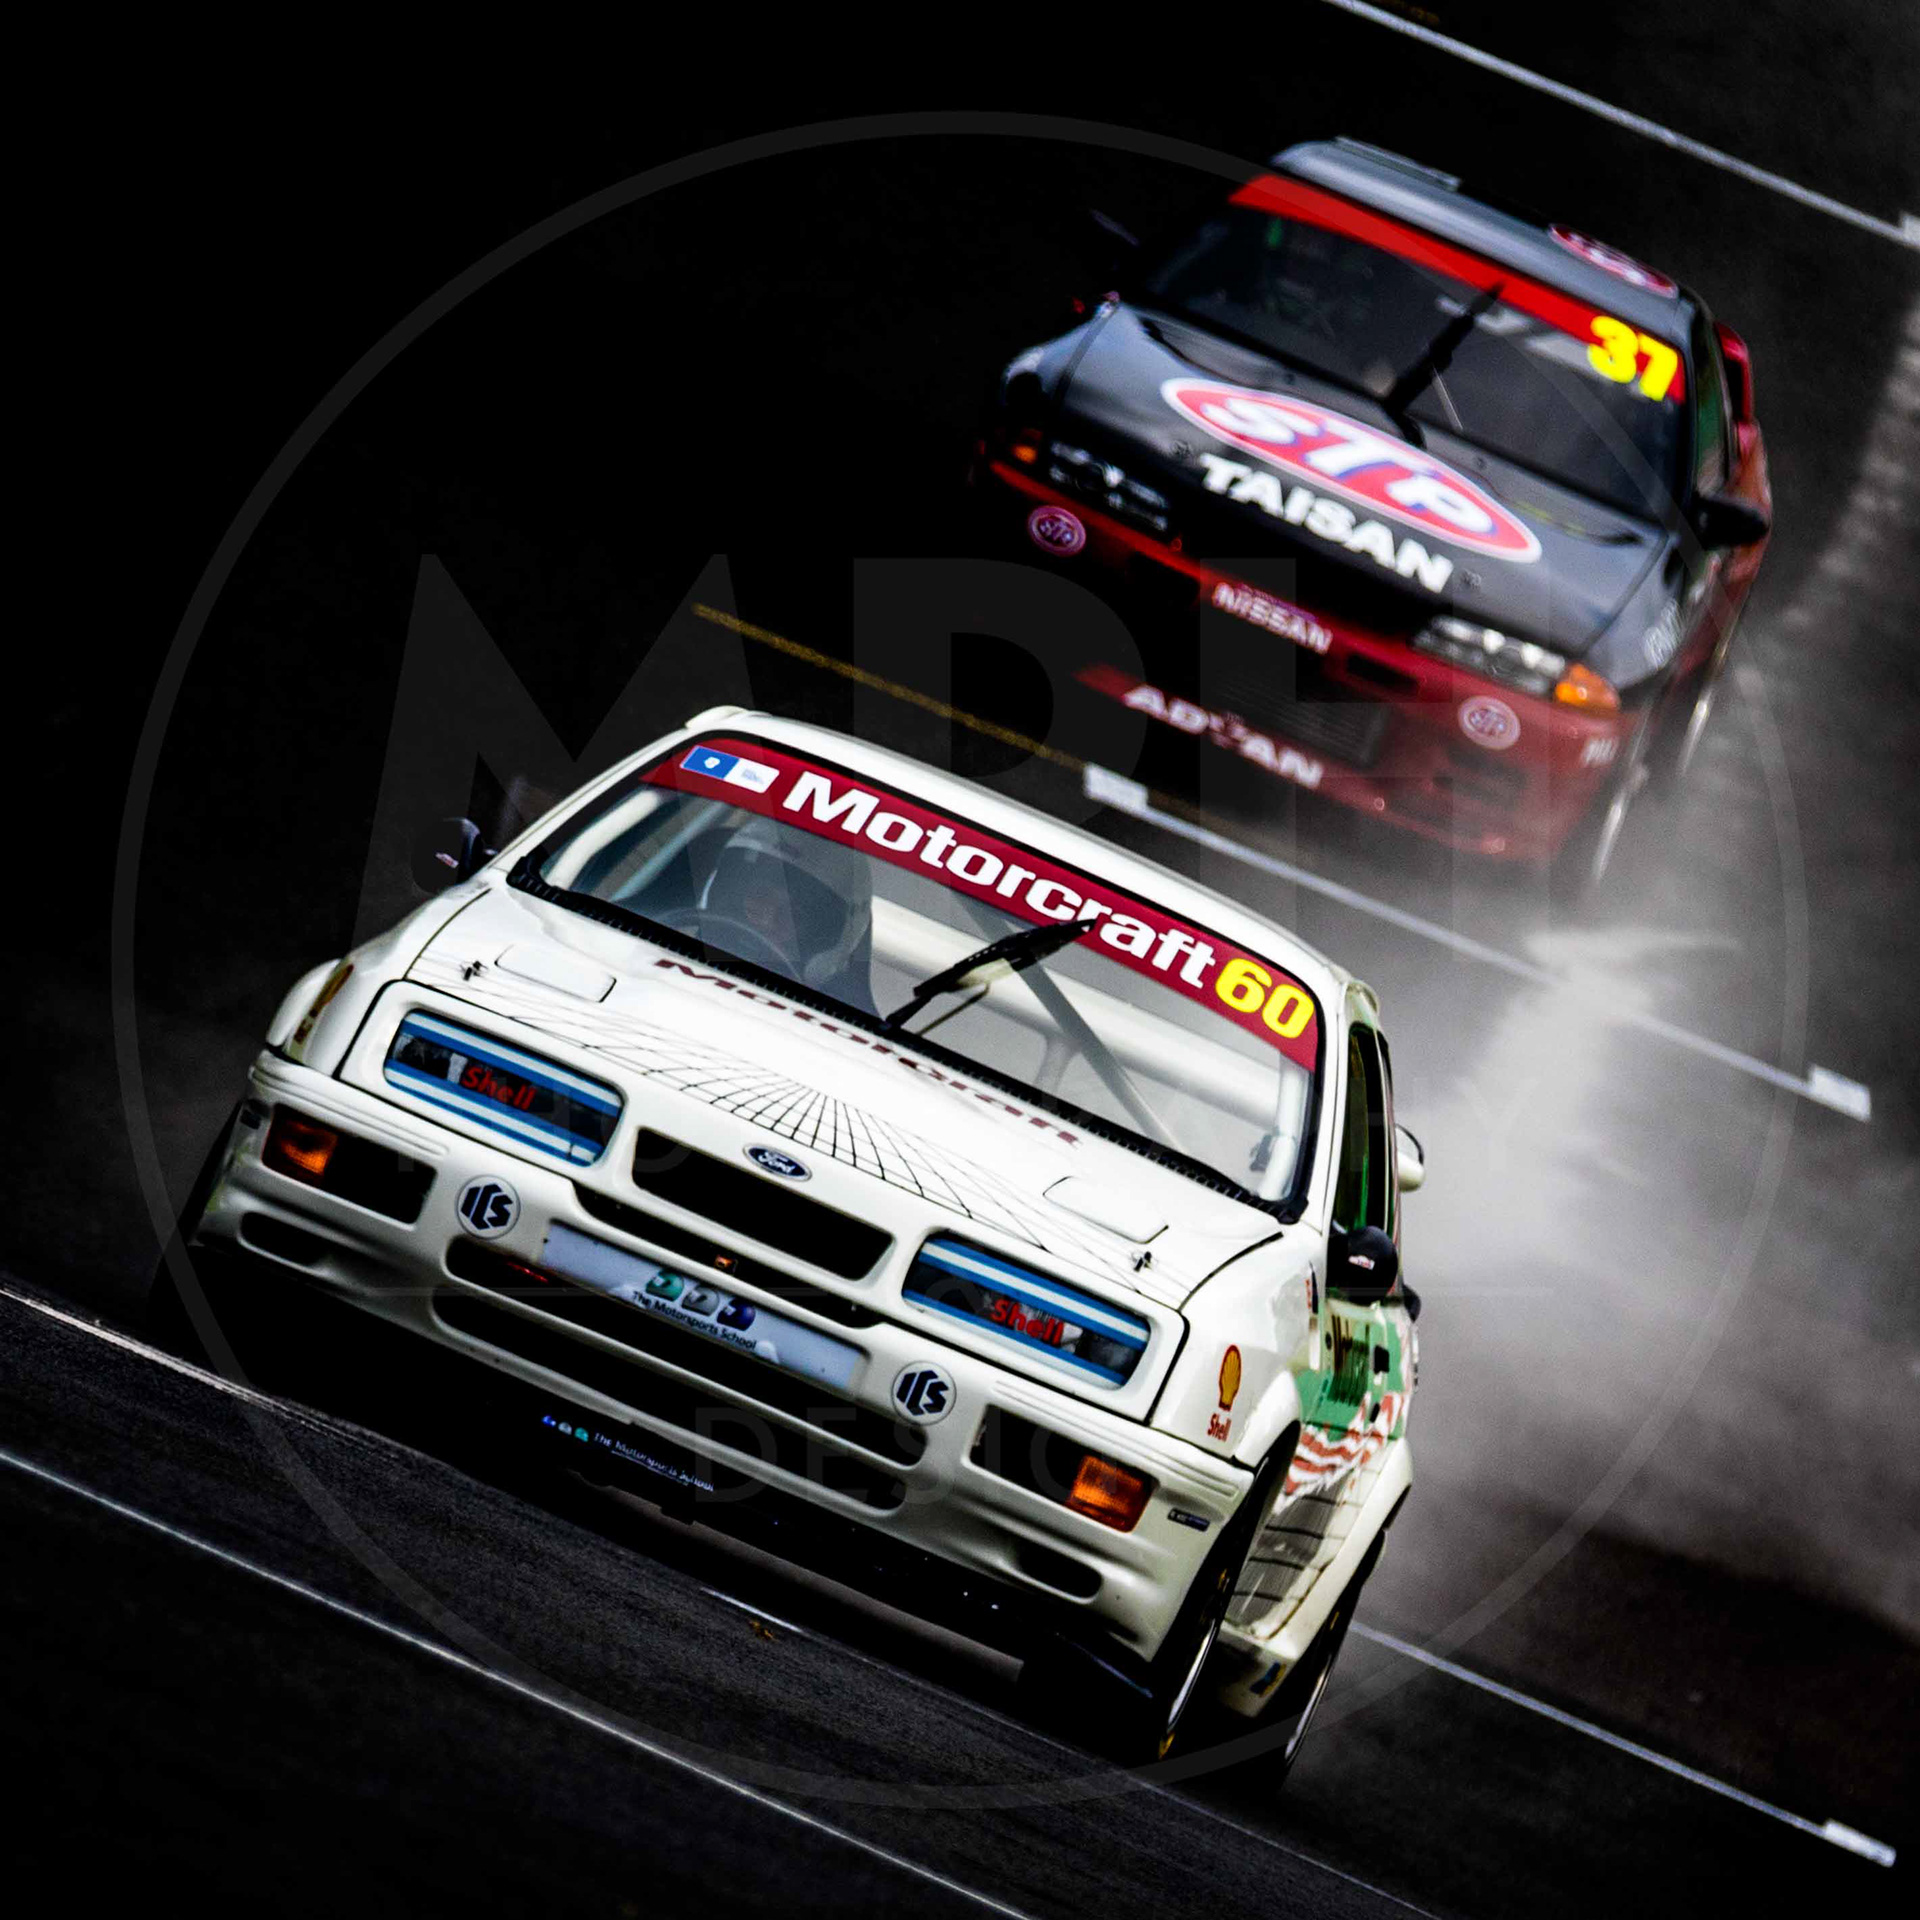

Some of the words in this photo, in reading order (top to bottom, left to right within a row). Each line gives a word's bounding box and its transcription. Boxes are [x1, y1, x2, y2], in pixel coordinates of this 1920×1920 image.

[1586, 315, 1681, 401] 37
[1198, 394, 1494, 534] STP
[1200, 452, 1453, 592] TAISAN
[1212, 582, 1334, 654] NISSAN
[782, 770, 1217, 988] Motorcraft
[1215, 957, 1316, 1041] 60
[460, 1064, 536, 1112] Shell
[633, 1291, 651, 1306] The
[653, 1300, 718, 1336] Motorsports
[721, 1328, 757, 1350] School
[989, 1298, 1065, 1346] Shell
[1206, 1413, 1232, 1443] Shell
